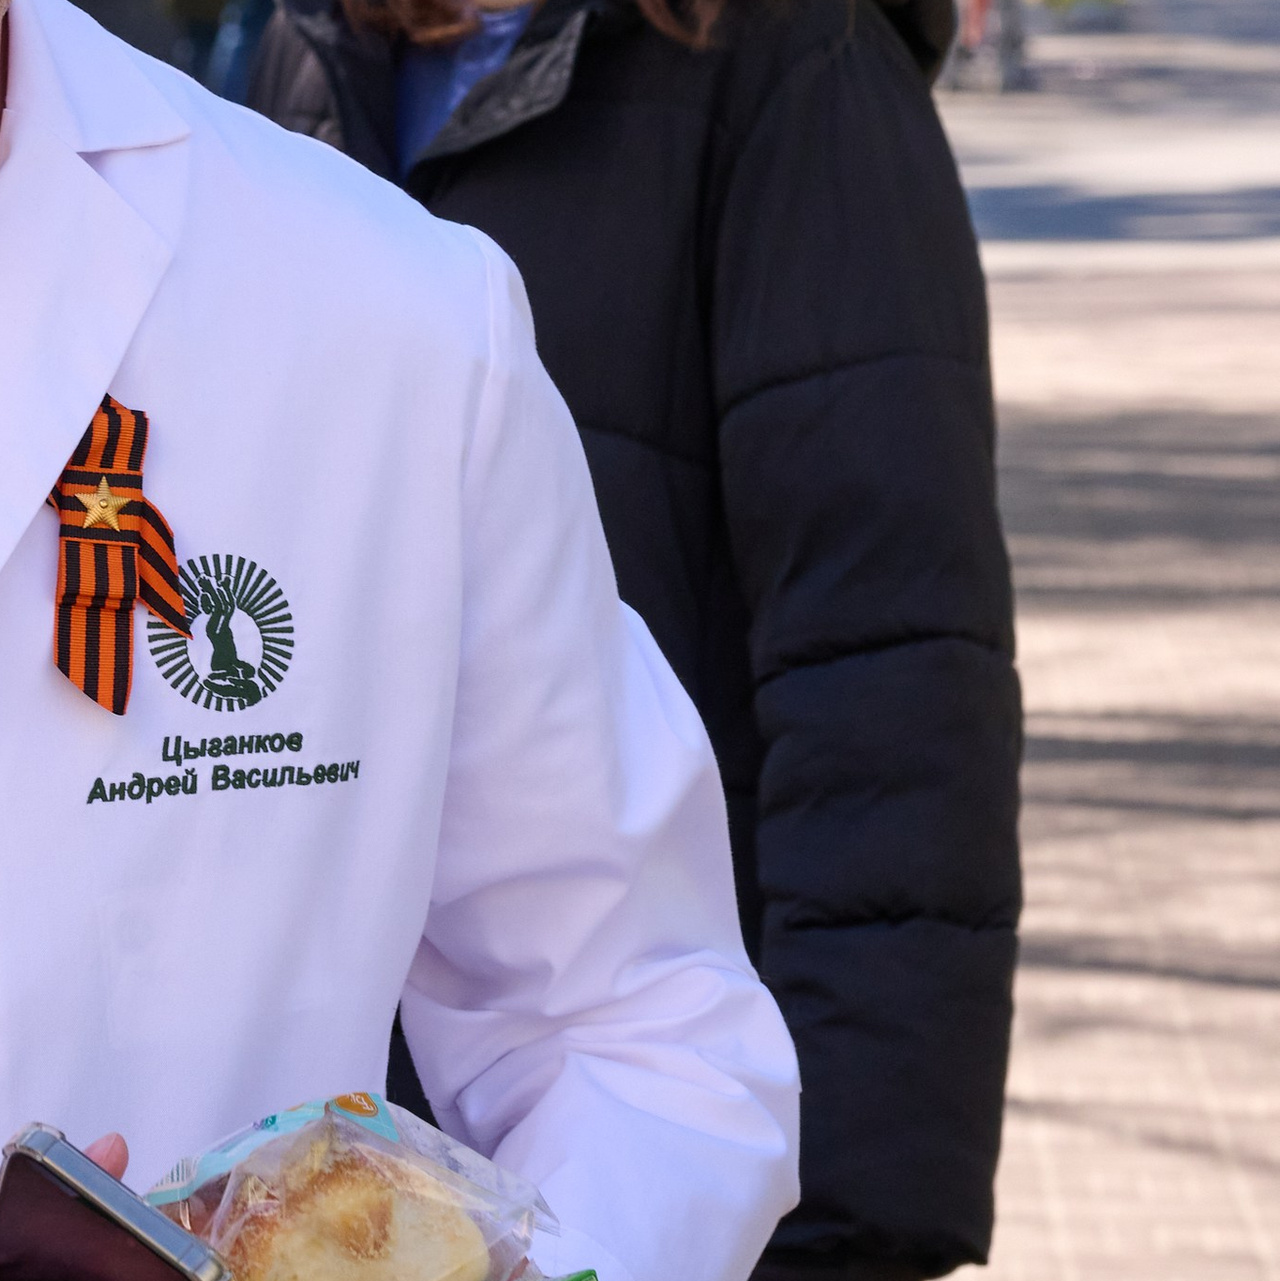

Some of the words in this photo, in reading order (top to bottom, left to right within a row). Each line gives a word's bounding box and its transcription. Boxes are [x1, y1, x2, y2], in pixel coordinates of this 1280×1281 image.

[161, 731, 303, 767] Цыганков
[86, 767, 198, 804] Андрей
[211, 760, 360, 791] Васильевич
